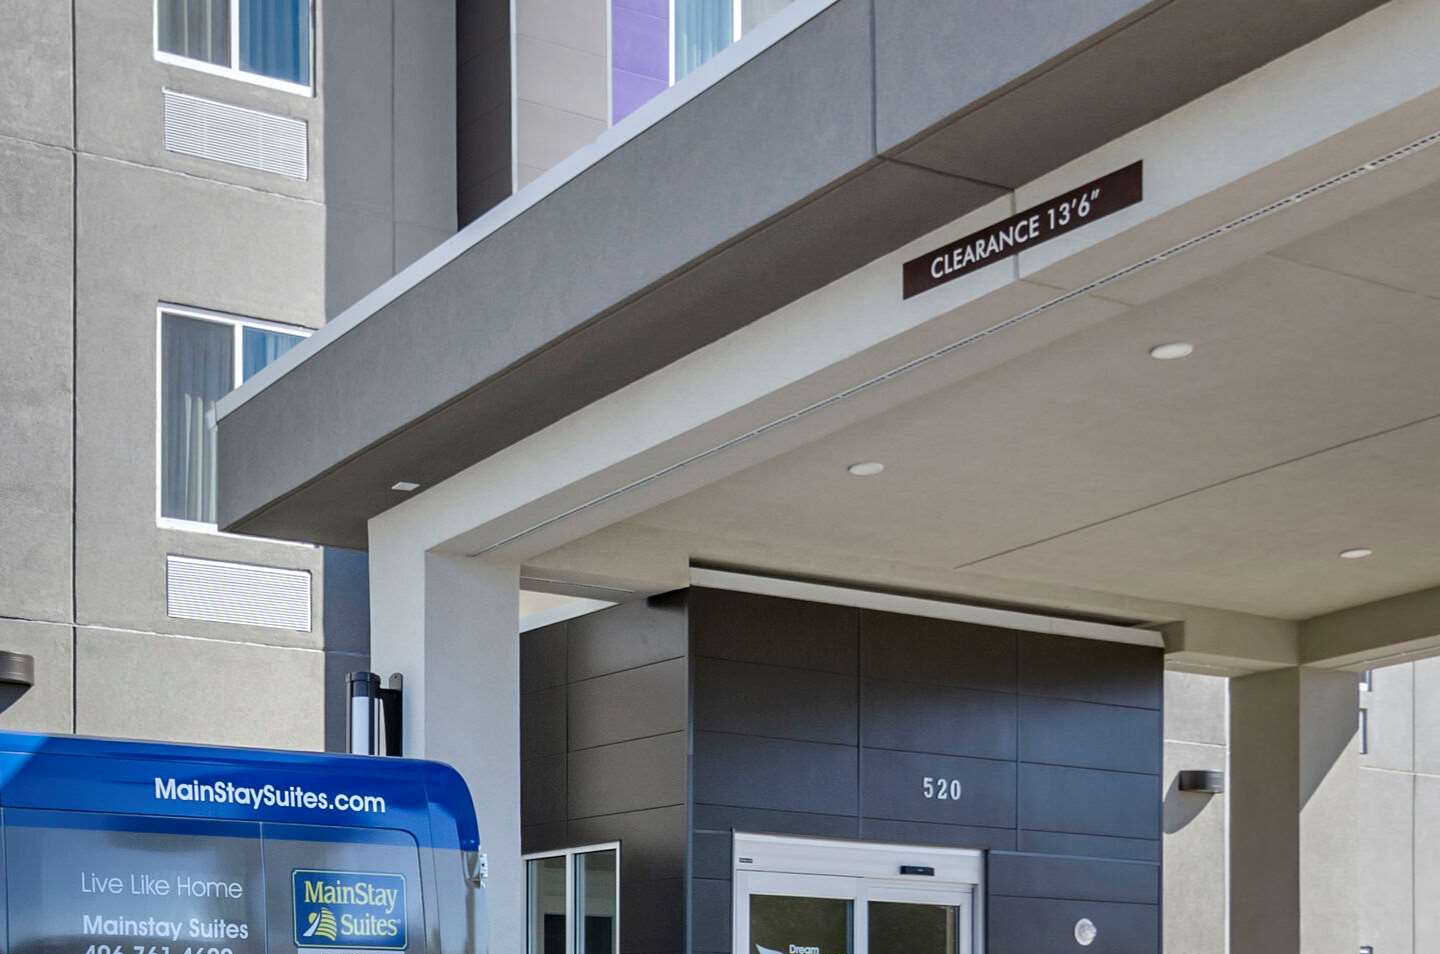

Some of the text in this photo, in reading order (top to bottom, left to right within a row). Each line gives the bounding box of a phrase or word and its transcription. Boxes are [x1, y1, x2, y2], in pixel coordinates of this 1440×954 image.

[930, 215, 1040, 279] CLEARANCE
[154, 777, 386, 814] MainStaySuites.com
[923, 776, 962, 801] 520
[81, 871, 244, 900] Live Like Home
[304, 879, 398, 914] MainStay
[83, 914, 249, 943] Mainstay Suites
[340, 912, 398, 936] Suites
[788, 944, 820, 954] Dream
